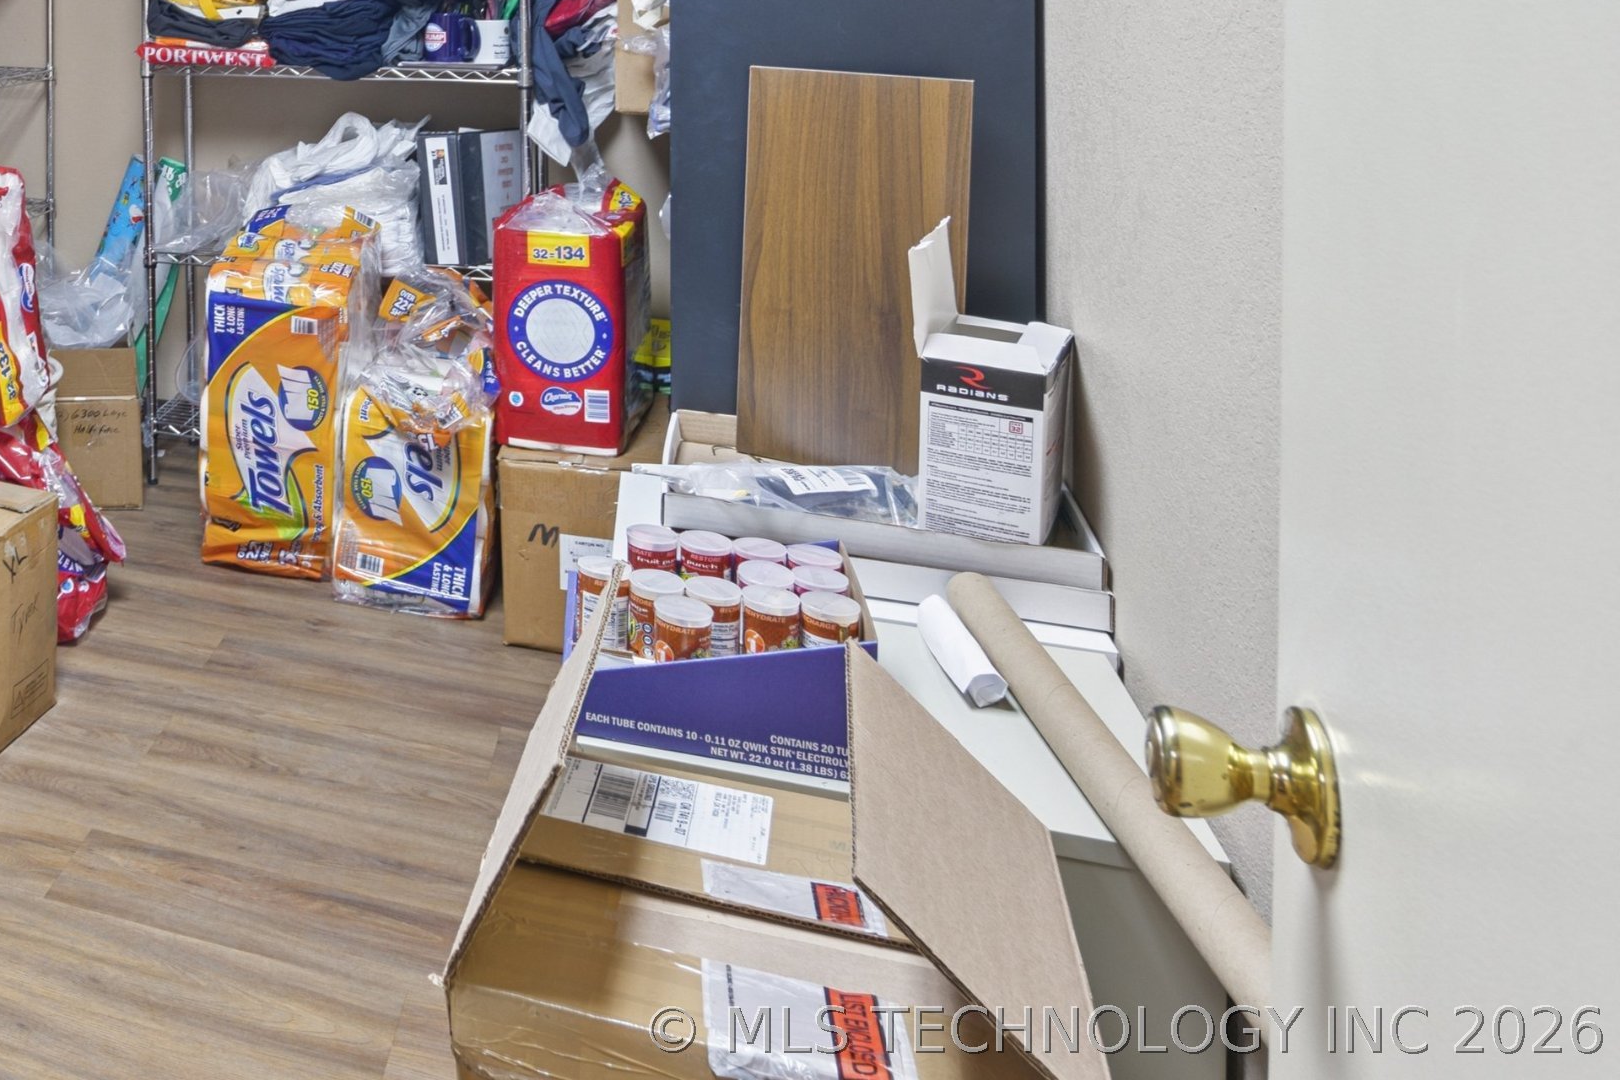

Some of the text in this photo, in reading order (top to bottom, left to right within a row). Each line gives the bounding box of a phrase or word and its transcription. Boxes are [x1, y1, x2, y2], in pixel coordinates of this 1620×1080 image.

[143, 46, 266, 67] PORTWEST
[272, 267, 286, 304] owels
[227, 306, 235, 326] LONG
[514, 284, 606, 321] DEEPER TEXTURE
[214, 304, 226, 333] THICK
[237, 307, 245, 335] LASTING
[516, 341, 606, 378] CLEANS BETTER
[307, 389, 319, 411] 150
[544, 391, 572, 403] Charmin
[244, 419, 252, 460] Premium
[241, 391, 294, 517] Towels
[404, 442, 443, 502] els
[312, 464, 323, 512] Absorbent
[361, 477, 373, 498] 150
[528, 523, 559, 548] M
[636, 556, 659, 565] fruit
[687, 559, 718, 570] punch
[585, 711, 610, 725] EACH
[611, 717, 636, 730] TUBE
[637, 721, 683, 739] CONTAINS
[686, 730, 697, 741] 10
[705, 733, 726, 746] 0.11
[728, 738, 741, 749] OZ
[742, 741, 769, 755] QWIK
[770, 735, 819, 751] CONTAINS
[821, 744, 834, 755] 20
[710, 746, 728, 757] NET
[730, 750, 747, 762] WT.
[749, 753, 771, 767] 22.0
[773, 758, 784, 768] oz
[785, 760, 813, 775] (1.38
[814, 763, 838, 780] LBS)
[840, 993, 867, 1019] LIST
